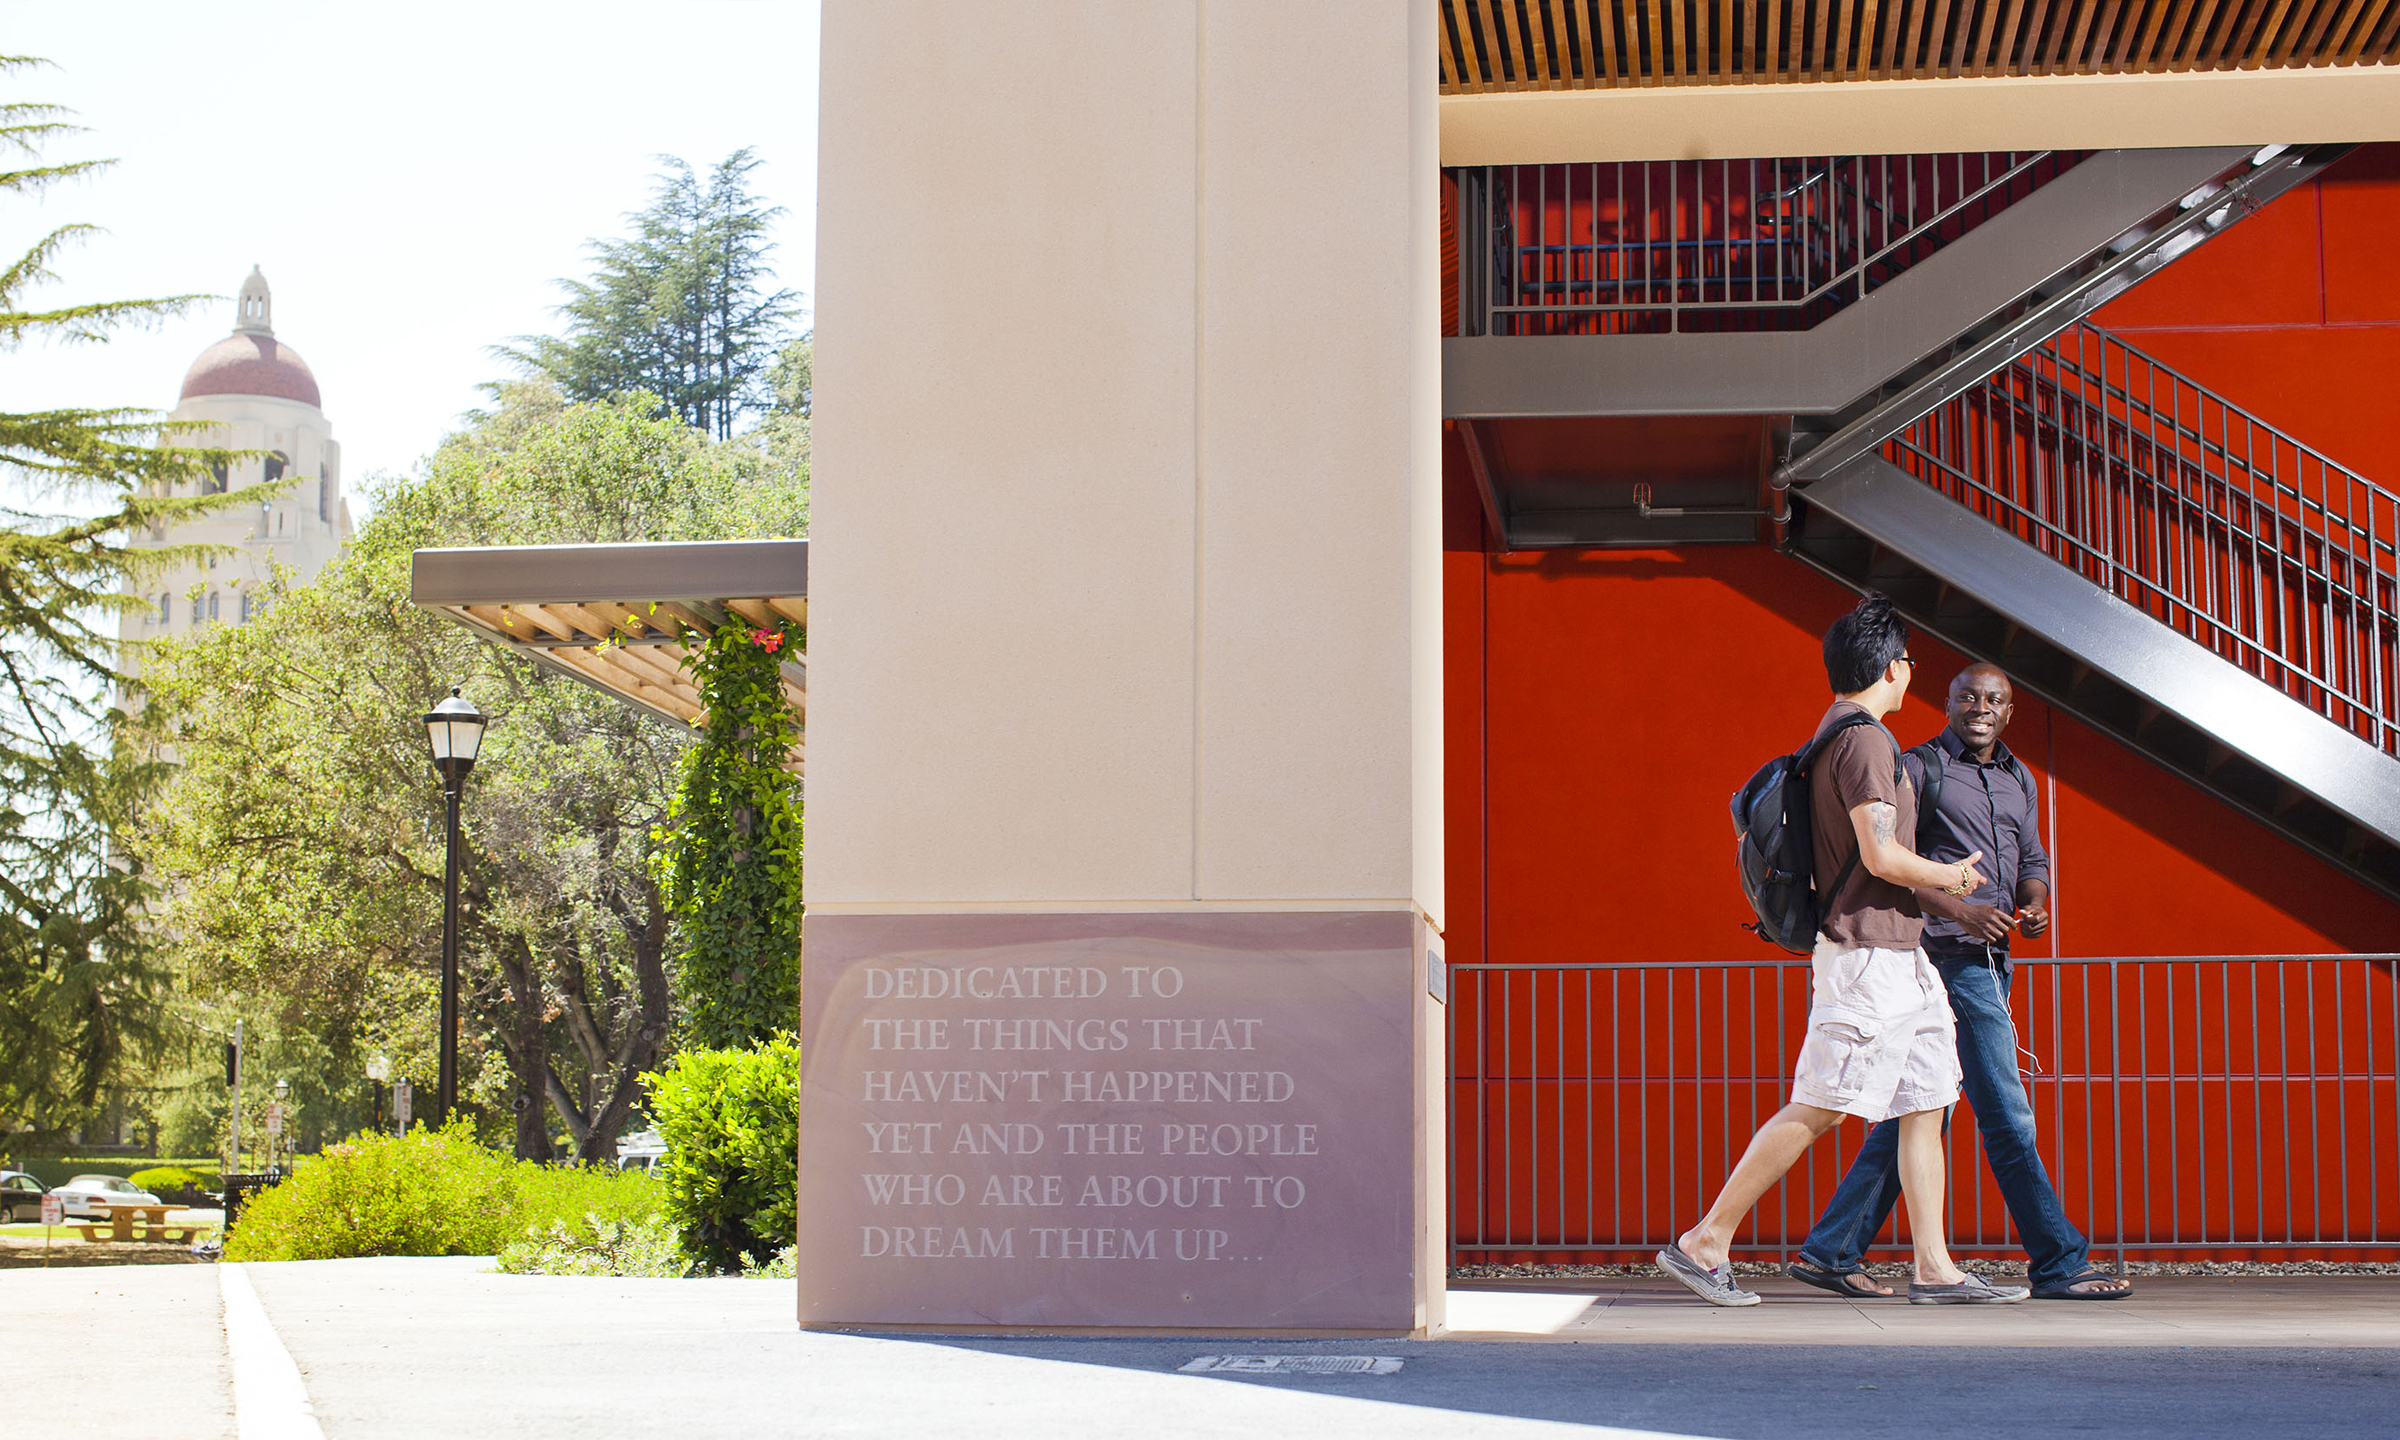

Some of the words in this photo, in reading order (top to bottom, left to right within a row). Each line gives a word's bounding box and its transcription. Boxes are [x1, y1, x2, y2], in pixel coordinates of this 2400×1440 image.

[864, 965, 1108, 998] DEDICATED
[1121, 965, 1184, 998] TO
[863, 1017, 949, 1050] THE
[963, 1017, 1129, 1051] THINGS
[1143, 1017, 1263, 1051] THAT
[1061, 1070, 1294, 1103] HAPPENED
[861, 1121, 941, 1154] YET
[949, 1122, 1044, 1155] AND
[1057, 1122, 1145, 1155] THE
[1160, 1123, 1319, 1156] PEOPLE
[861, 1173, 965, 1206] WHO
[979, 1174, 1063, 1207] ARE
[1076, 1174, 1231, 1208] ABOUT
[1245, 1175, 1306, 1209] TO
[860, 1226, 1015, 1259] DREAM
[1029, 1227, 1159, 1261] THEM
